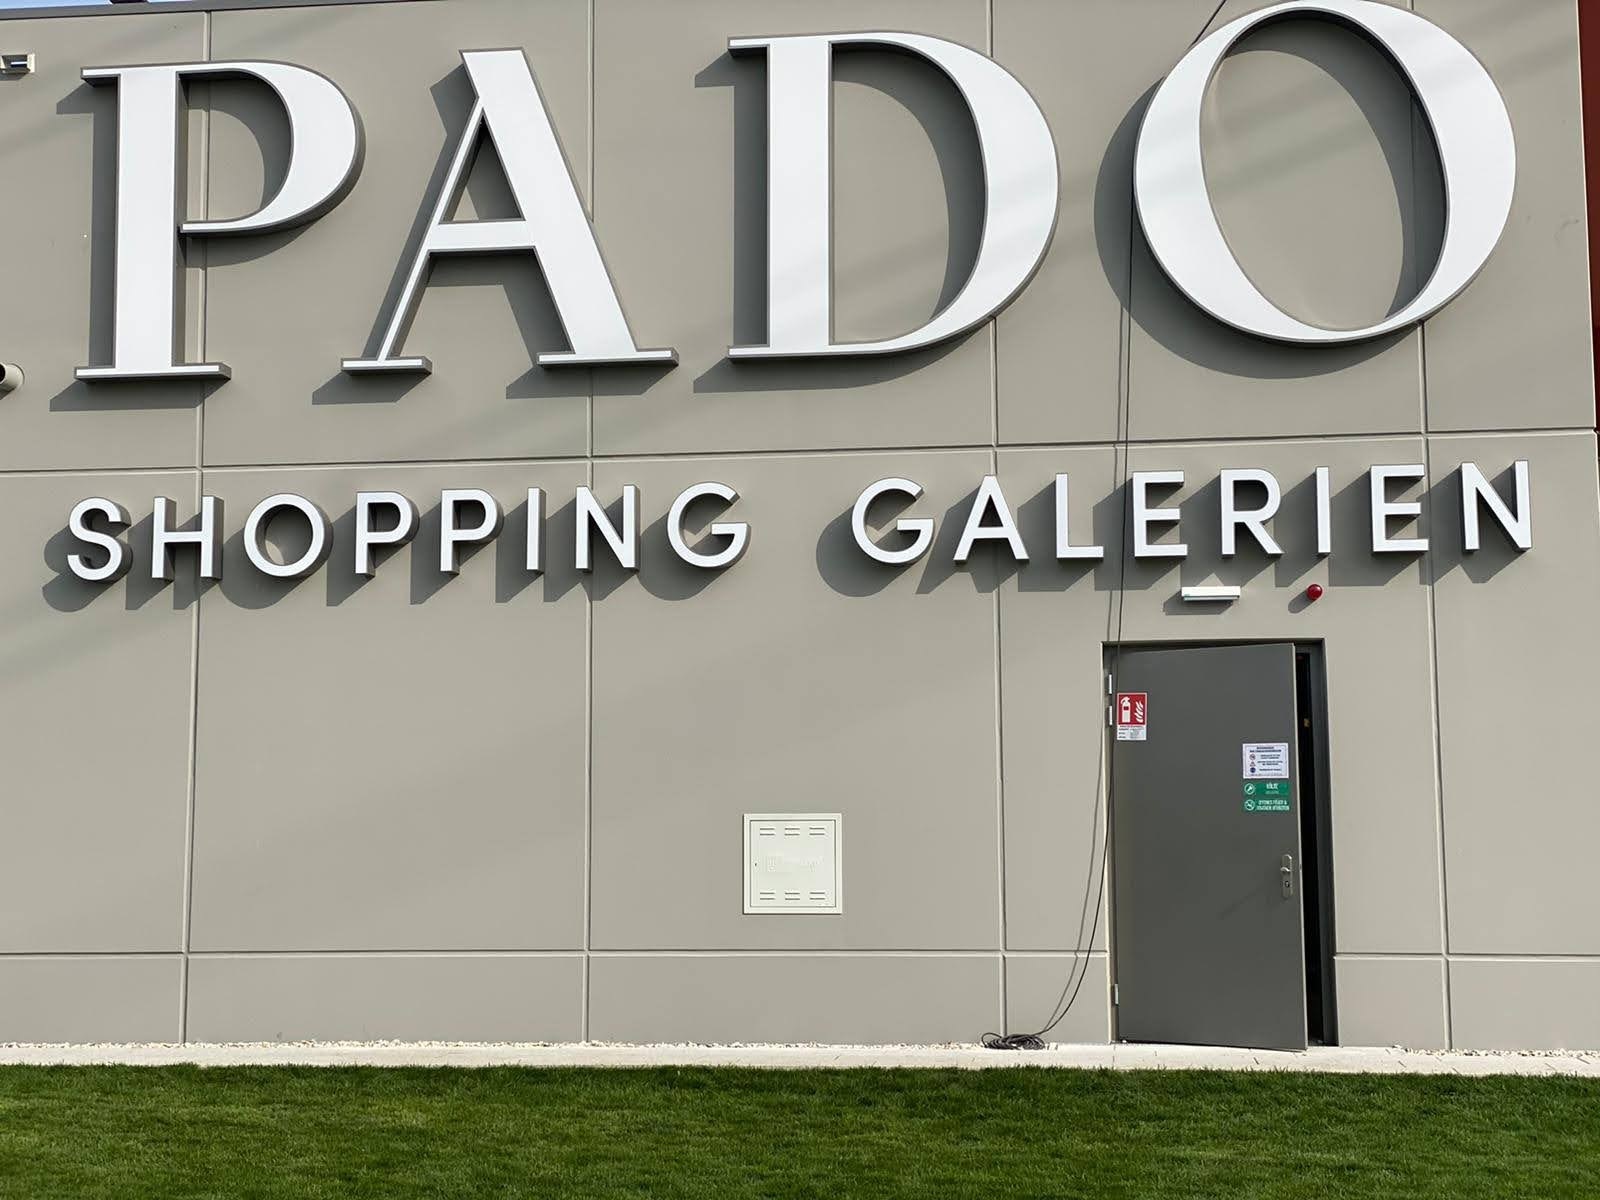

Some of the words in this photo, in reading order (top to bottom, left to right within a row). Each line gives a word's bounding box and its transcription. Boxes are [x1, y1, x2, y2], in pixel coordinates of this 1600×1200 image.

[75, 0, 1517, 378] PADO
[66, 481, 752, 583] SHOPPING
[851, 460, 1533, 565] GALERIEN
